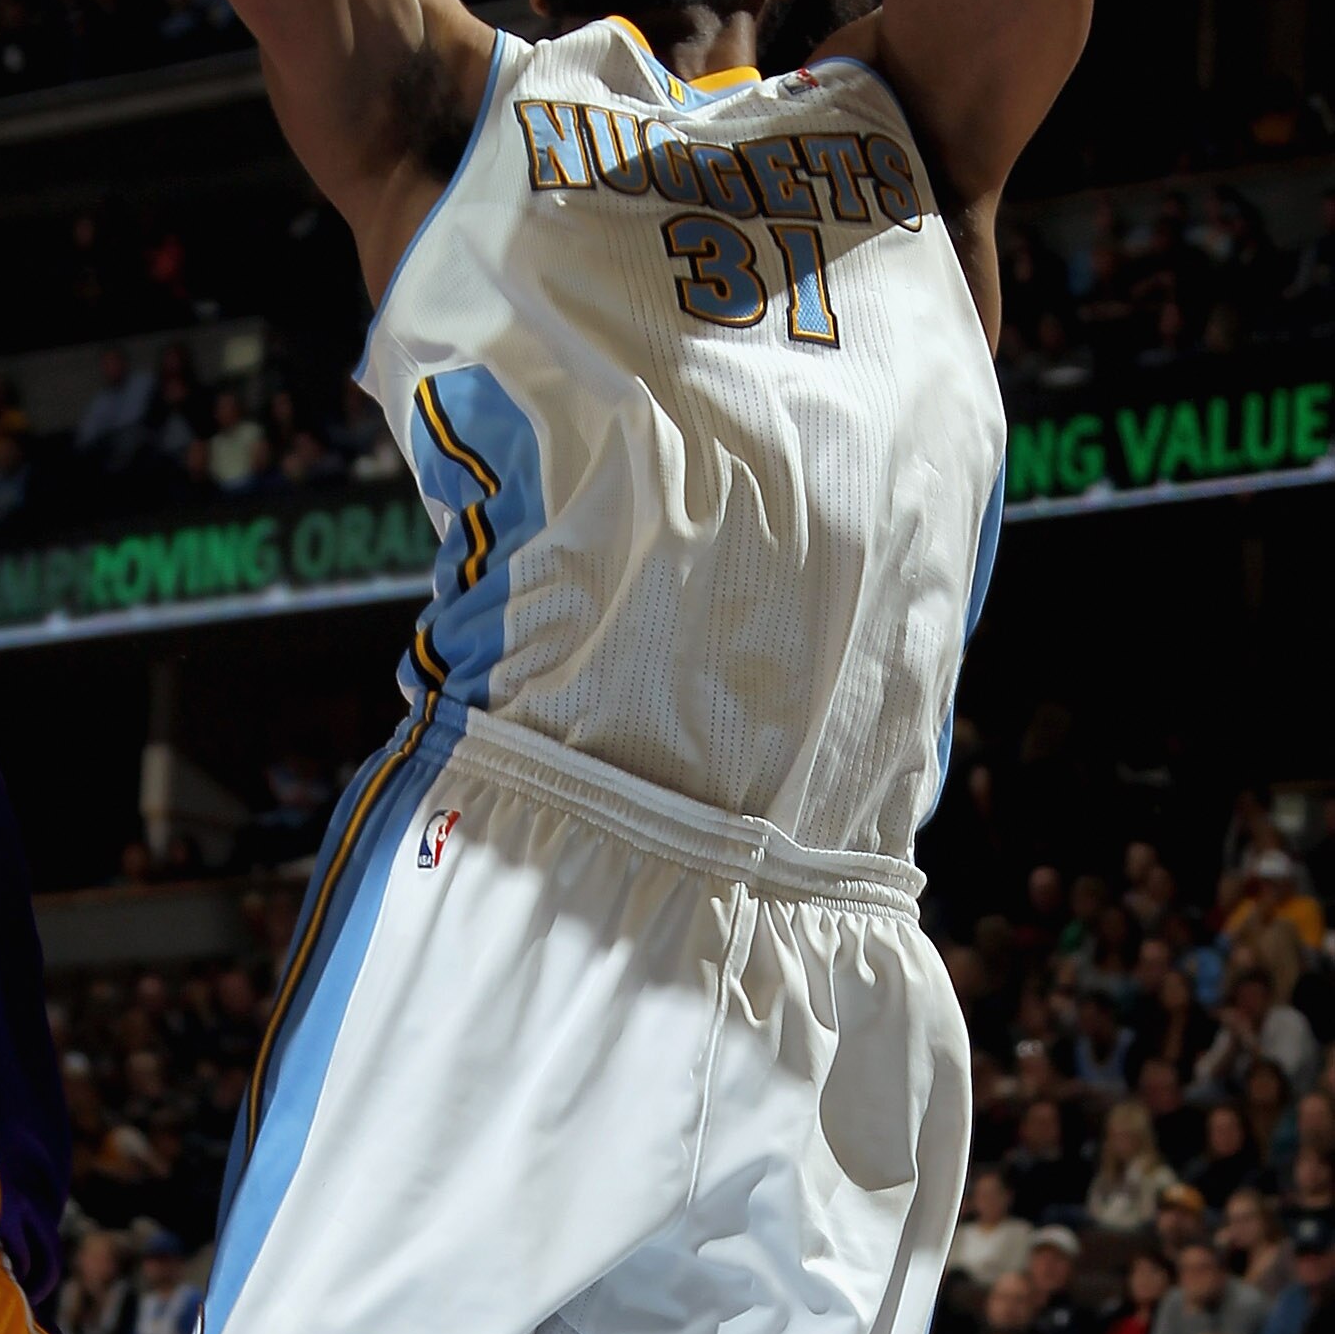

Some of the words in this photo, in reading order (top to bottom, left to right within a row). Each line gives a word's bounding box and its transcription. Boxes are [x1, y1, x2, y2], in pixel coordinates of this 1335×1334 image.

[514, 100, 922, 232] NUGGETS
[660, 211, 840, 349] 31
[1114, 380, 1333, 486] VALUE
